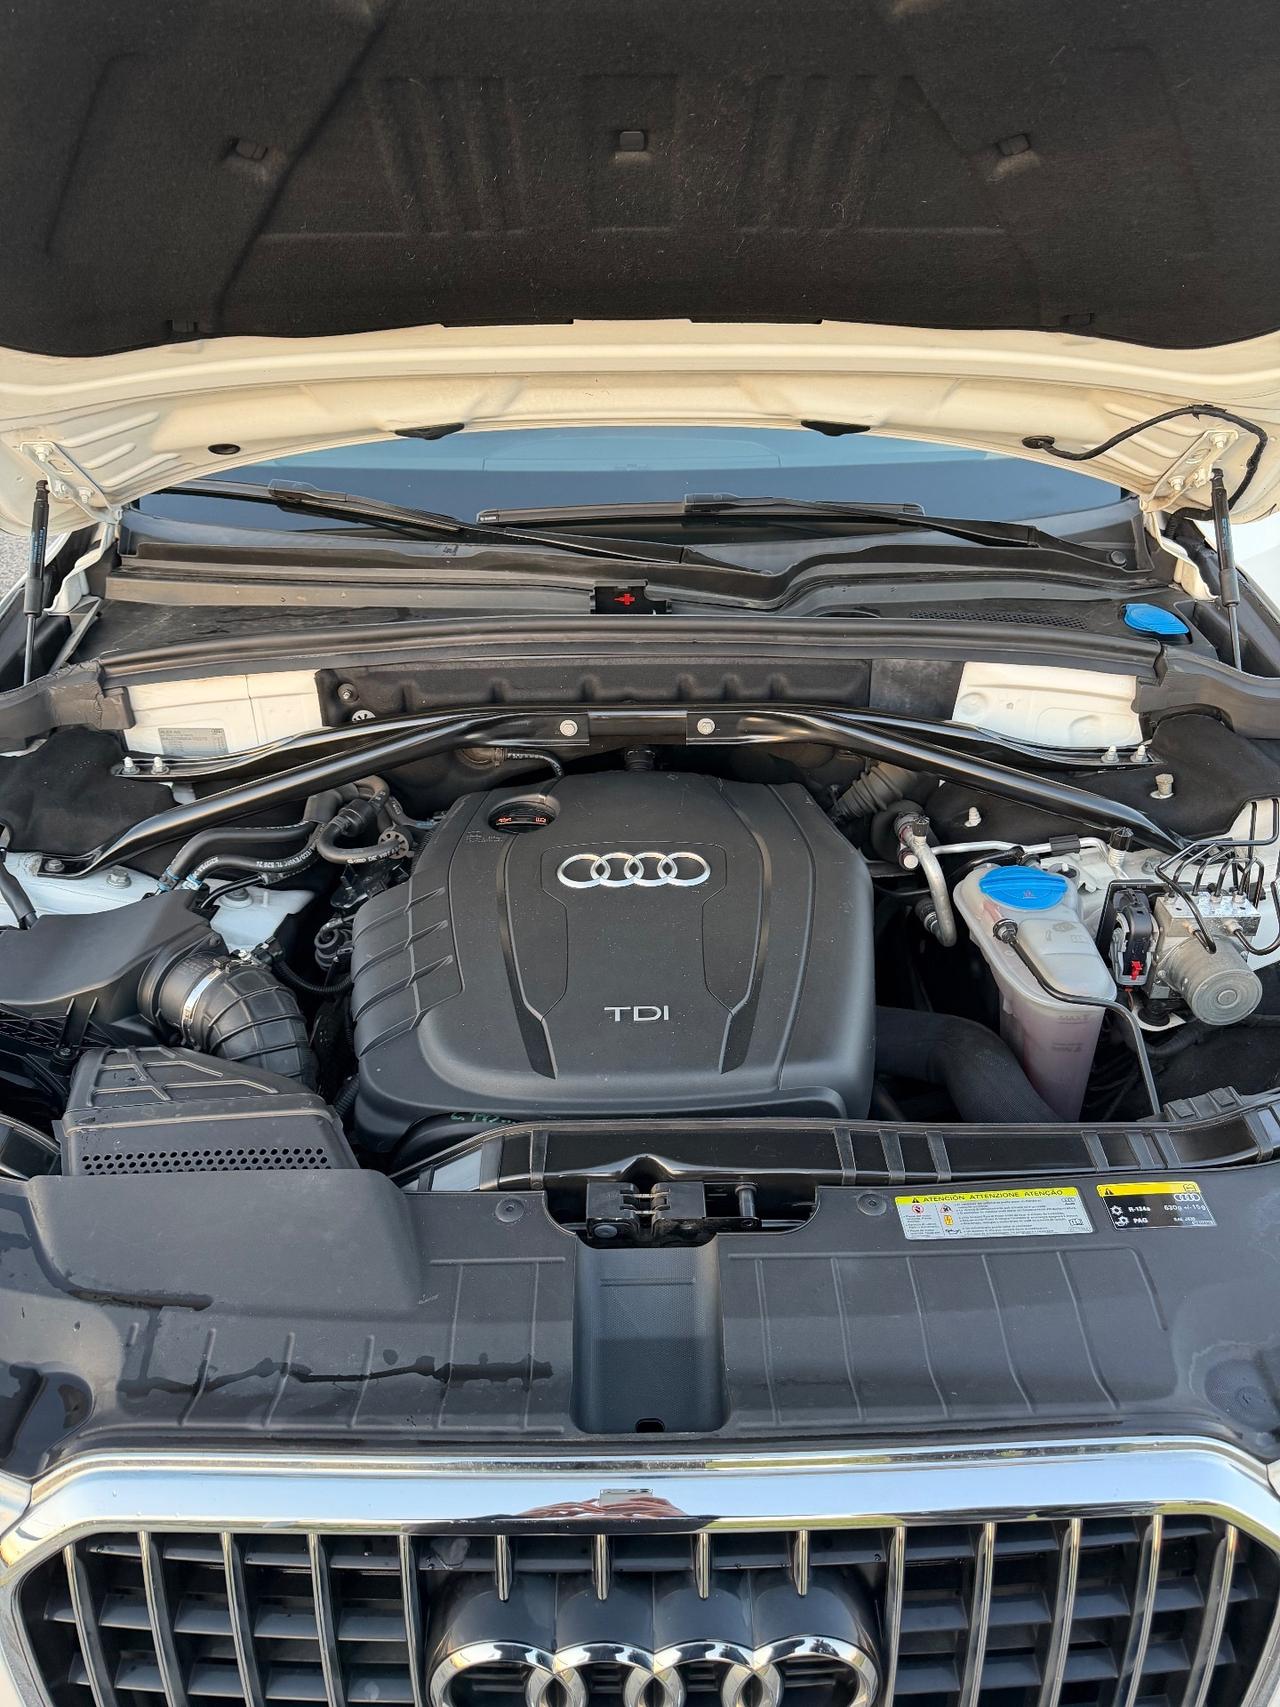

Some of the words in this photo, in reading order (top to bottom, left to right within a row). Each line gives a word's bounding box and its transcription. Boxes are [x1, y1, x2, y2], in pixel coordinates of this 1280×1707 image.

[604, 1005, 669, 1022] TDI
[923, 1194, 965, 1202] ATENCIÓN
[969, 1192, 1020, 1200] ATTENZIONE
